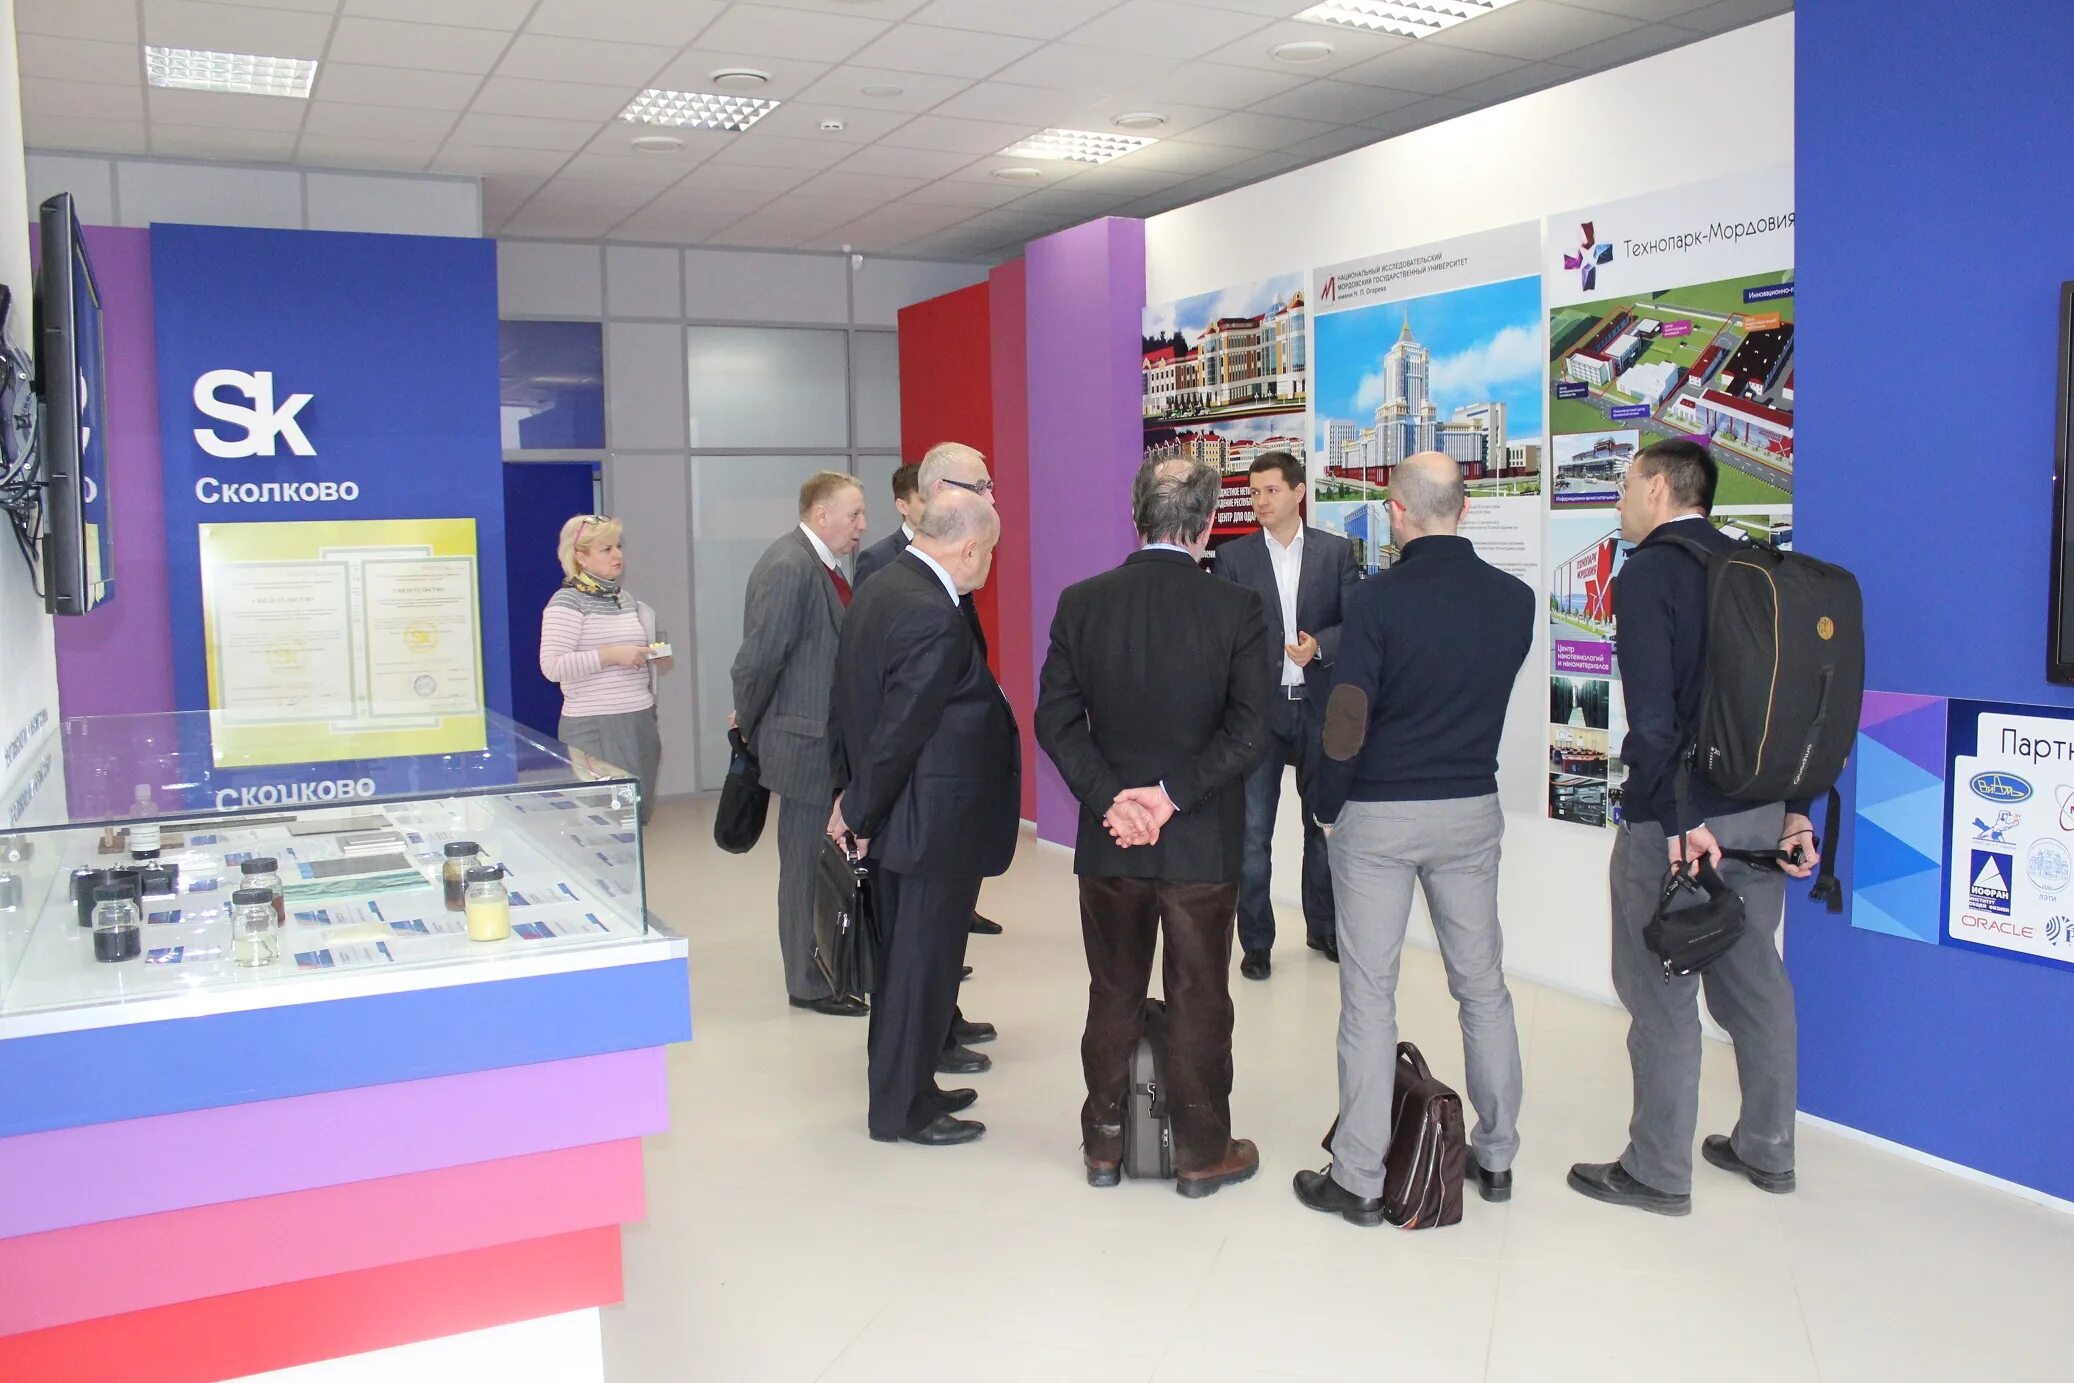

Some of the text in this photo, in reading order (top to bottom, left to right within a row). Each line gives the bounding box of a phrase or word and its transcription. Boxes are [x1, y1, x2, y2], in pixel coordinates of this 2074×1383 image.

[1623, 212, 1795, 259] Технопарк-Мордовия
[1337, 253, 1443, 281] НАЦИОНАЛЬНЫЙ ИССЛЕДОВАТЕЛЬСКИЙ
[1337, 258, 1469, 291] МОРДОВСКИЙ ГОСУДАРСТВЕННЫЙ УНИВЕРСИТЕТ
[192, 368, 318, 458] Sk
[1557, 644, 1575, 653] Центр
[1557, 653, 1604, 662] нанотехнологий
[1562, 662, 1610, 671] наноматериалов
[1971, 886, 2009, 900] ИОФРАН
[1961, 915, 2034, 938] ORACLE
